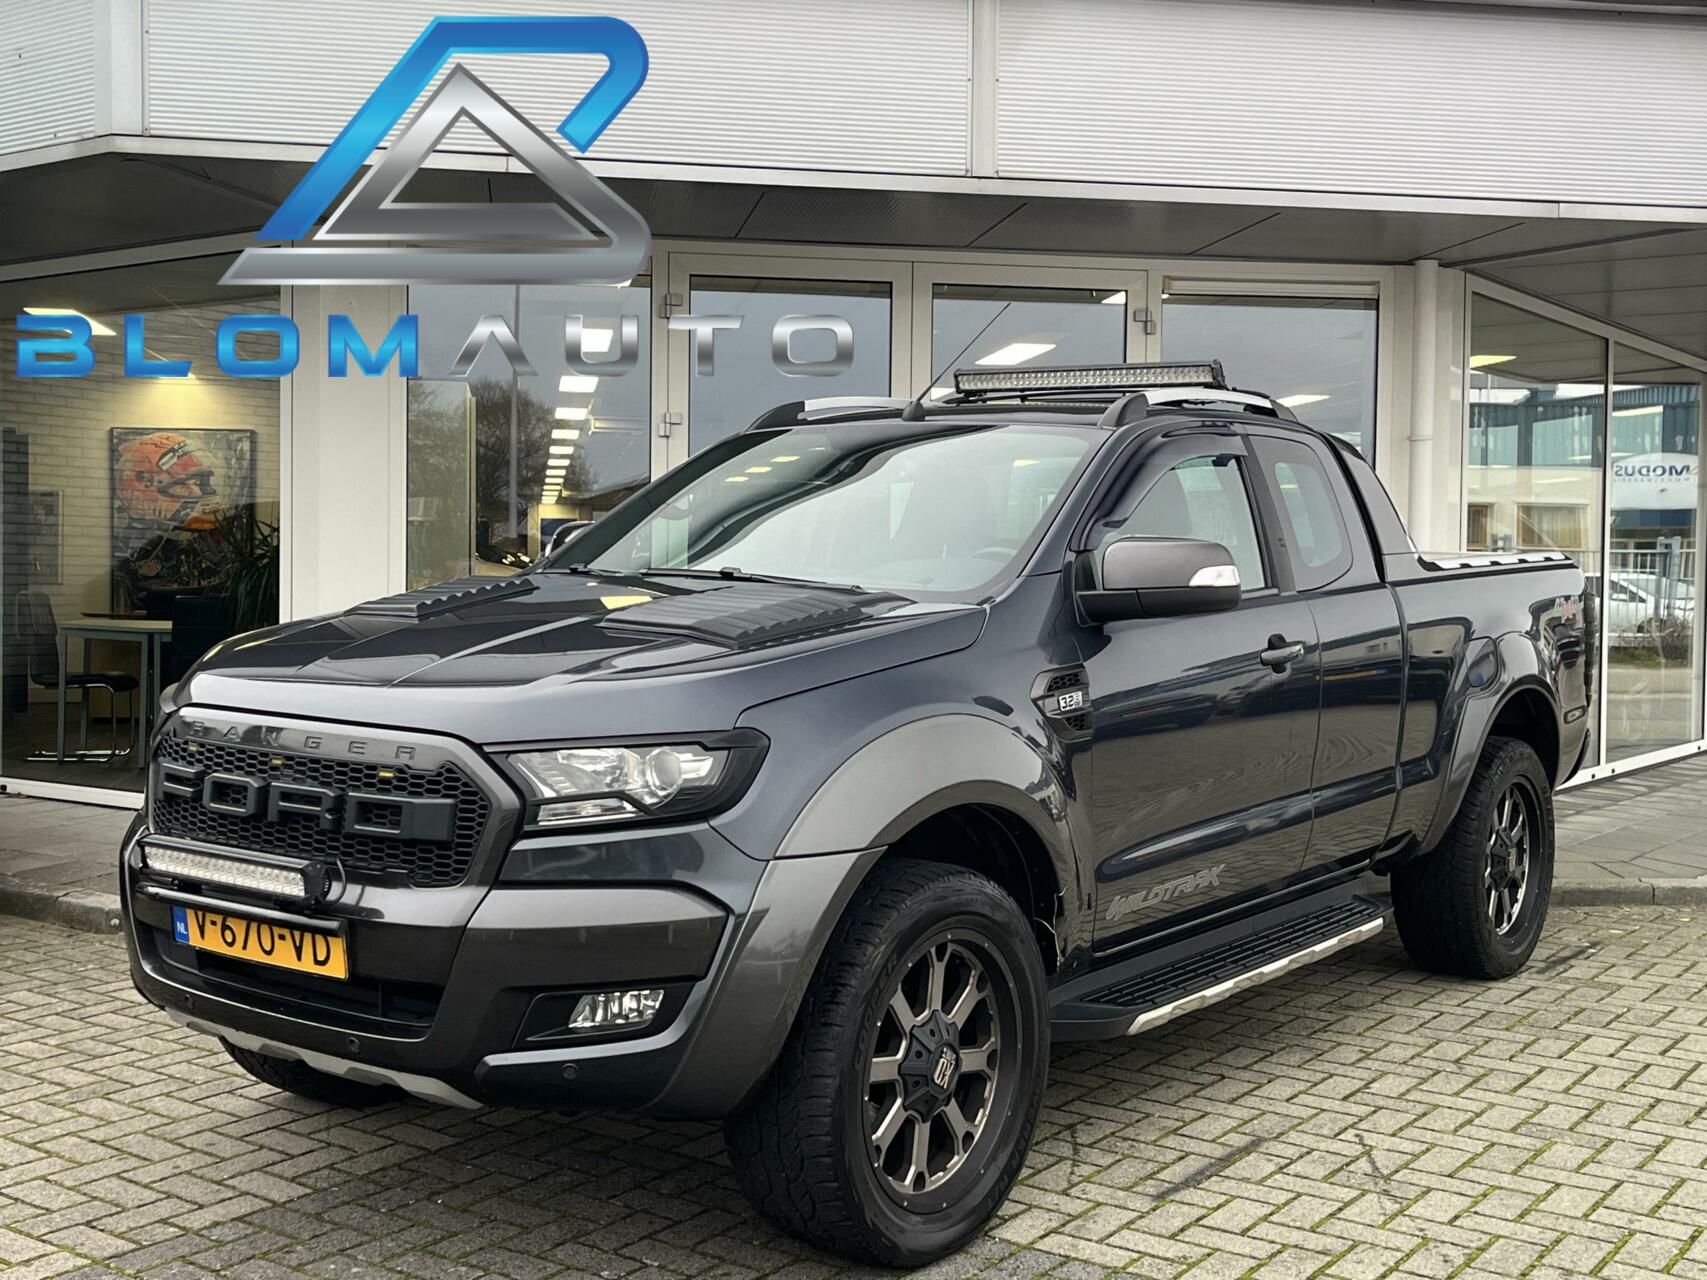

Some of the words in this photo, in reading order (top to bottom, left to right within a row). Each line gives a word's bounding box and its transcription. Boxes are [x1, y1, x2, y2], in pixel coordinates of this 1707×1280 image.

[189, 720, 416, 760] RANGER
[157, 762, 456, 843] FORD
[1106, 864, 1226, 920] WILDTRAK
[176, 921, 188, 934] NL
